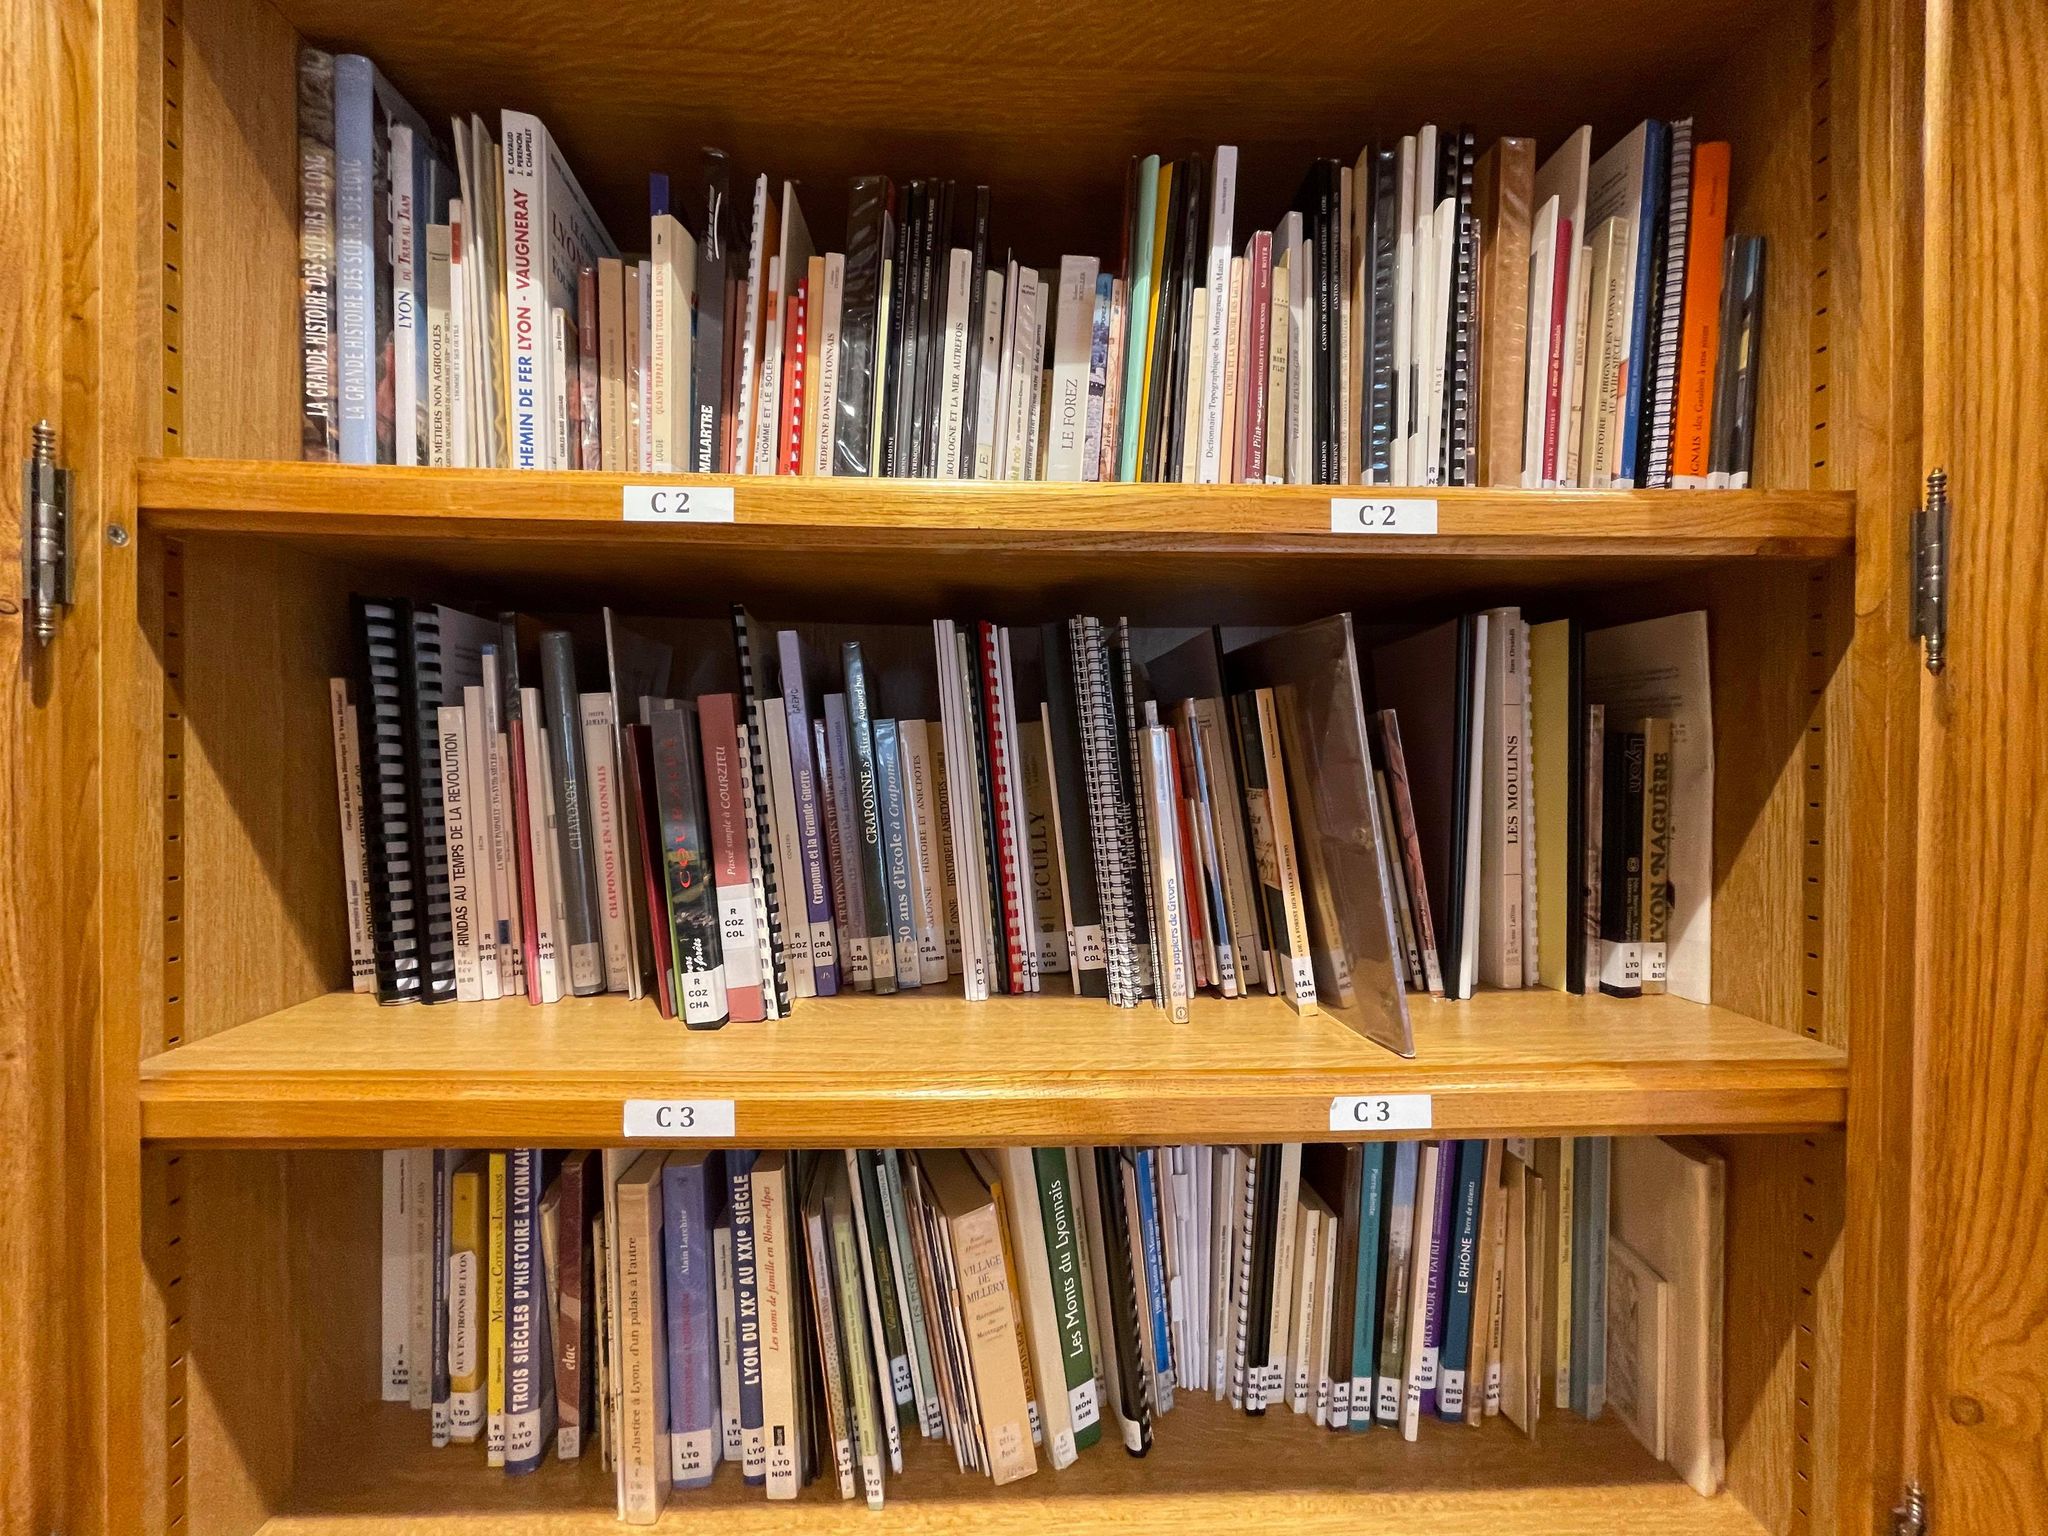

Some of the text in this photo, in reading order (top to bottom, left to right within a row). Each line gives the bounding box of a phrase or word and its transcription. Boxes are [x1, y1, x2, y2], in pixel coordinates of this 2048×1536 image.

[506, 132, 514, 165] CLAVAUD
[524, 128, 532, 167] CHAPPELET
[343, 195, 362, 211] DE
[513, 189, 530, 290] VAUGNERAY
[305, 155, 329, 416] LA GRANDE HISTOIRE DES SCIEURS DE LONG
[344, 268, 364, 290] DES
[655, 288, 663, 297] LE
[344, 294, 364, 348] HISTOIRE
[516, 307, 532, 350] LYON
[655, 300, 664, 332] TOURNER
[655, 334, 664, 360] FAISAIT
[824, 333, 836, 380] LYONNAIS
[1206, 258, 1224, 458] Dictionnaire Topographique des Montagnes du Matin
[345, 353, 365, 400] GRANDE
[518, 357, 532, 382] FER
[656, 362, 664, 388] TEPPAZ
[432, 325, 443, 467] ES MÉTIERS NON AGRICOLES
[518, 387, 533, 408] DE
[656, 390, 664, 415] QUAND
[764, 392, 771, 402] LE
[823, 382, 832, 393] LE
[946, 322, 964, 475] BOULOGNE ET LA MER AUTREFOIS
[345, 406, 365, 419] LA
[764, 408, 770, 418] ET
[822, 396, 832, 420] DANS
[1062, 379, 1078, 450] LE FOREZ
[1599, 398, 1608, 412] DE
[518, 413, 534, 469] HEMIN
[699, 406, 714, 473] MALARTRE
[762, 423, 770, 462] L'HOMME
[1596, 418, 1607, 470] L'HISTOIRE
[652, 492, 690, 513] C 2
[1360, 506, 1396, 526] C 2
[444, 732, 460, 802] REVOLUTION
[716, 746, 730, 809] COURZIEU
[883, 752, 902, 817] Craponne
[1506, 735, 1518, 844] LES MOULINS
[448, 806, 462, 822] LA
[564, 778, 582, 850] CHAPONOST
[890, 822, 901, 830] à
[912, 755, 928, 872] HISTOIRE ET ANECDOTES
[450, 825, 463, 840] DE
[597, 766, 619, 918] CHAPONOST-EN-LYONNAIS
[723, 820, 734, 848] simple
[800, 770, 824, 904] Craponne et la Grande Guerre
[452, 844, 466, 880] TEMPS
[724, 850, 736, 876] Passé
[890, 834, 908, 889] d'Ecole
[1027, 811, 1052, 900] ECULLY
[454, 885, 467, 900] AU
[897, 894, 910, 920] ans
[455, 906, 470, 946] RINDAS
[724, 918, 744, 927] COZ
[726, 930, 744, 938] COL
[1165, 878, 1182, 966] papiers de Givors
[816, 950, 832, 958] COL
[1295, 980, 1312, 988] HAL
[1296, 990, 1316, 998] LOM
[656, 1106, 694, 1128] C 3
[1354, 1102, 1390, 1122] C 3
[1048, 1180, 1070, 1248] Lyonnais
[1456, 1181, 1474, 1294] LE RHÔNE Terre de talents
[626, 1237, 638, 1276] l'autre
[761, 1186, 779, 1352] Les noms de famille en Rhône-Alpes
[964, 1254, 1001, 1278] VILLAGE
[1058, 1254, 1072, 1272] du
[734, 1174, 760, 1384] LYON DU XXe AU XXIe SIÈCLE
[966, 1280, 1006, 1303] MILLERY
[978, 1272, 990, 1286] DE
[1426, 1239, 1440, 1320] POUR LA PATRIE
[457, 1254, 468, 1372] AUX ENVIRONS DE LYON
[508, 1220, 530, 1412] TROIS SIÈCLES D'HISTOIRE
[628, 1291, 642, 1326] palais
[1062, 1278, 1079, 1329] Monts
[562, 1344, 576, 1370] elac
[628, 1330, 640, 1356] d'un
[1070, 1330, 1084, 1357] Les
[630, 1398, 640, 1406] à
[630, 1410, 641, 1454] Justice
[747, 1446, 764, 1455] LYO
[772, 1470, 792, 1478] NOM
